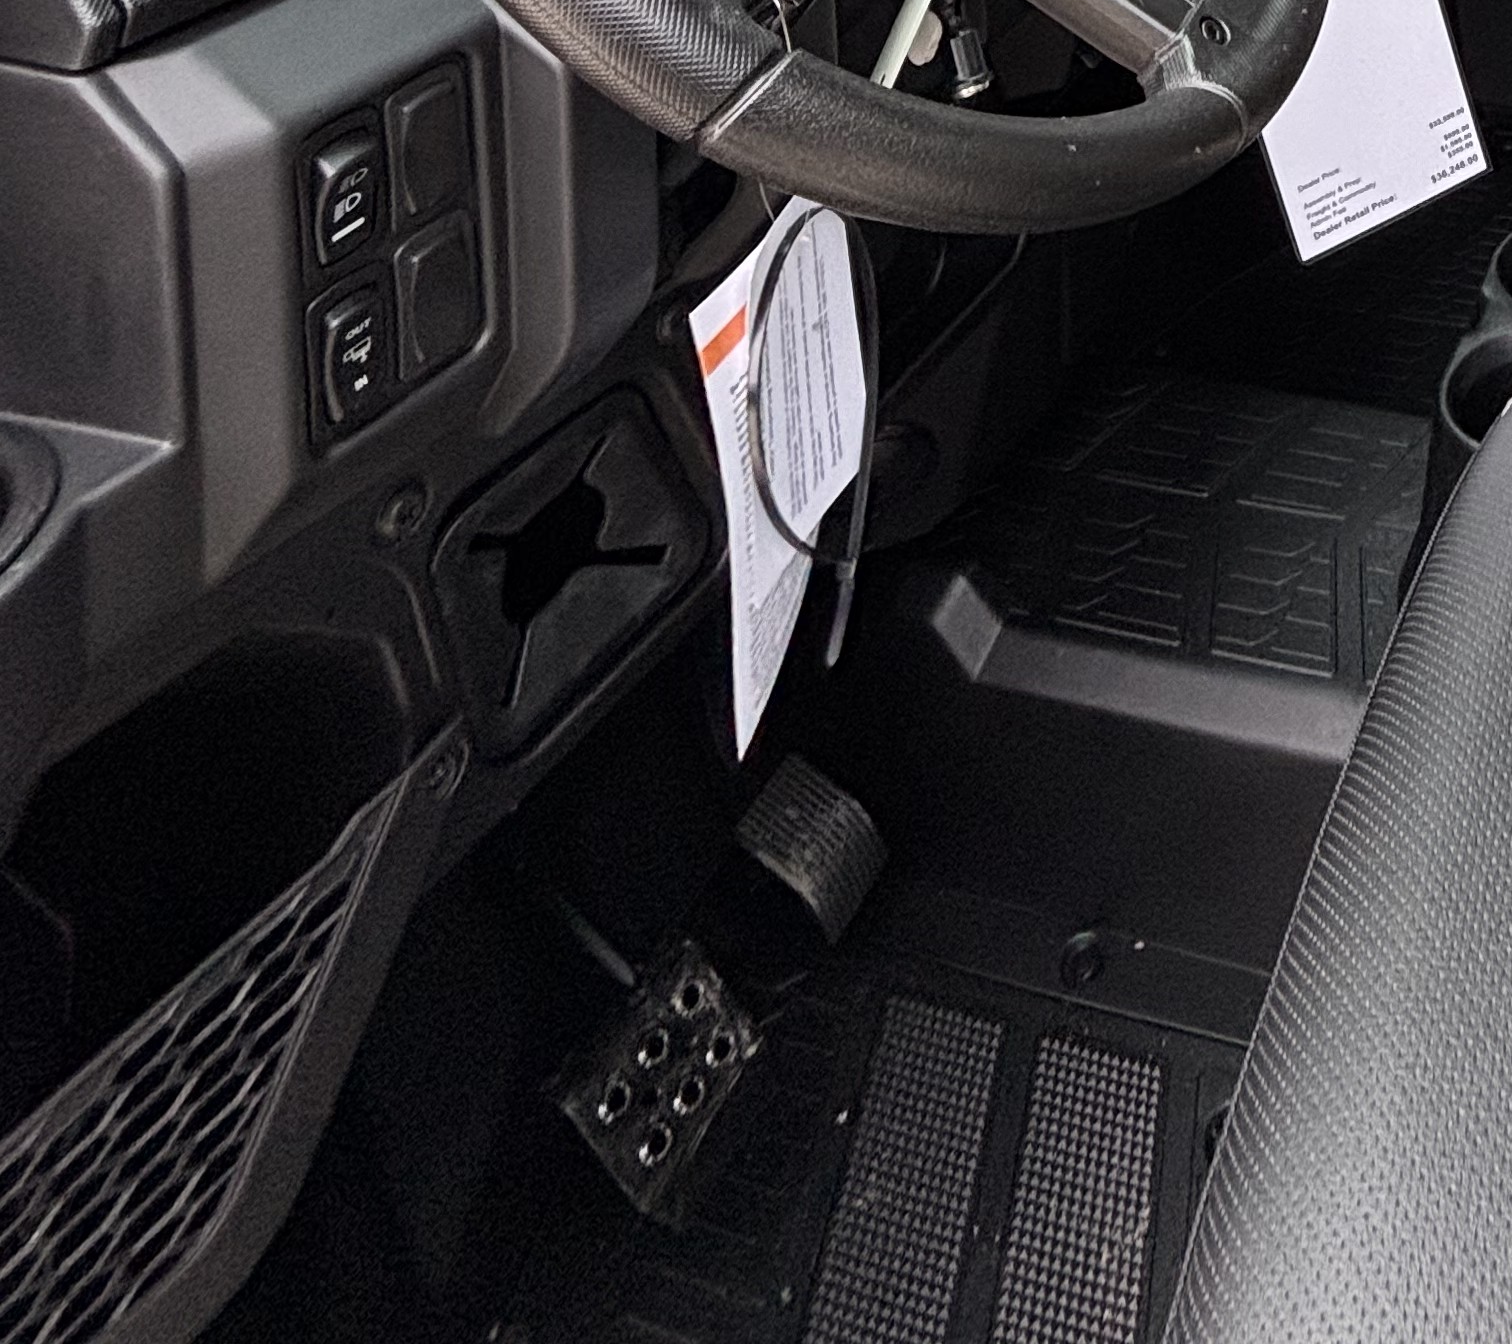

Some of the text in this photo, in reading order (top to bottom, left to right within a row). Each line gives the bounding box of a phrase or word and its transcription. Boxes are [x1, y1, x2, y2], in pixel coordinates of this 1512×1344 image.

[1431, 153, 1479, 184] $36,248.00
[1313, 221, 1342, 240] Dealer
[1344, 206, 1370, 225] Retail
[345, 316, 372, 340] OUT
[354, 374, 369, 392] IN
